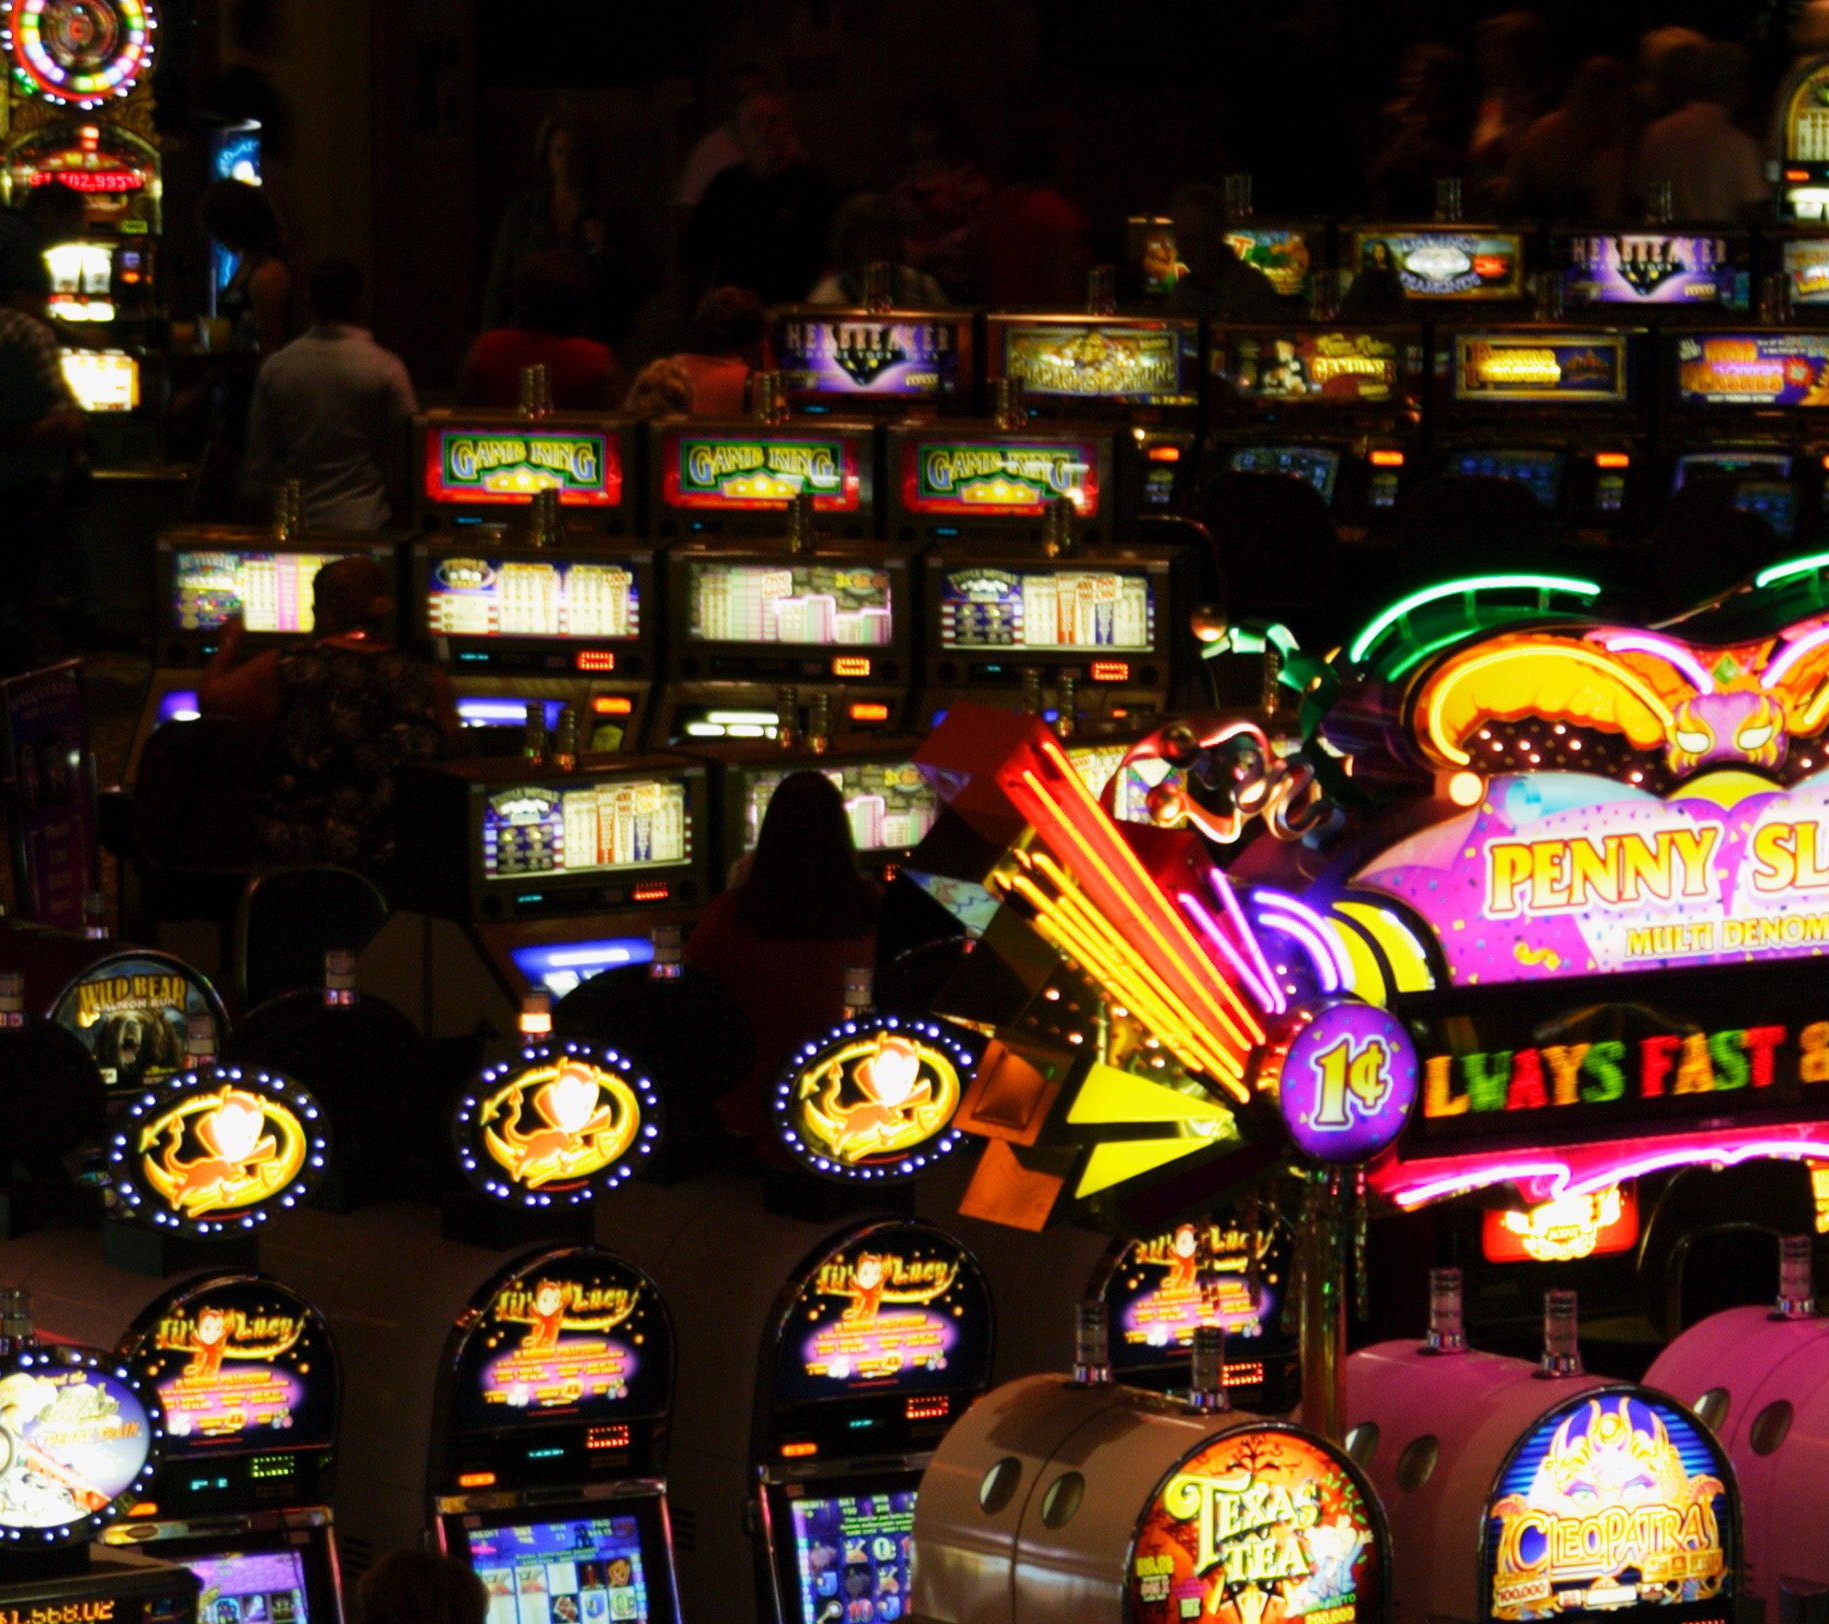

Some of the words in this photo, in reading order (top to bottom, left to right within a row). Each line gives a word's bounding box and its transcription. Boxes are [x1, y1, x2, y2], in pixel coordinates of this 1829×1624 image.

[450, 440, 527, 480] GAME
[530, 442, 598, 482] KING
[689, 445, 766, 486] GAME
[768, 446, 836, 487] KING
[926, 452, 1003, 492] GAME
[1485, 827, 1719, 912] PENNY
[1625, 922, 1716, 958] MULTI
[77, 982, 129, 1011] WILD
[133, 974, 187, 1004] BEAR
[1310, 1033, 1394, 1131] 1¢
[1424, 1040, 1626, 1118] LWAYS
[1641, 1026, 1785, 1099] FAST
[892, 1257, 952, 1286] Lucy
[570, 1286, 632, 1315] Lucy
[234, 1311, 298, 1341] Lucy
[1163, 1471, 1321, 1577] TEXAS
[1509, 1504, 1711, 1578] CLEOPATRA
[1223, 1534, 1312, 1583] TEA
